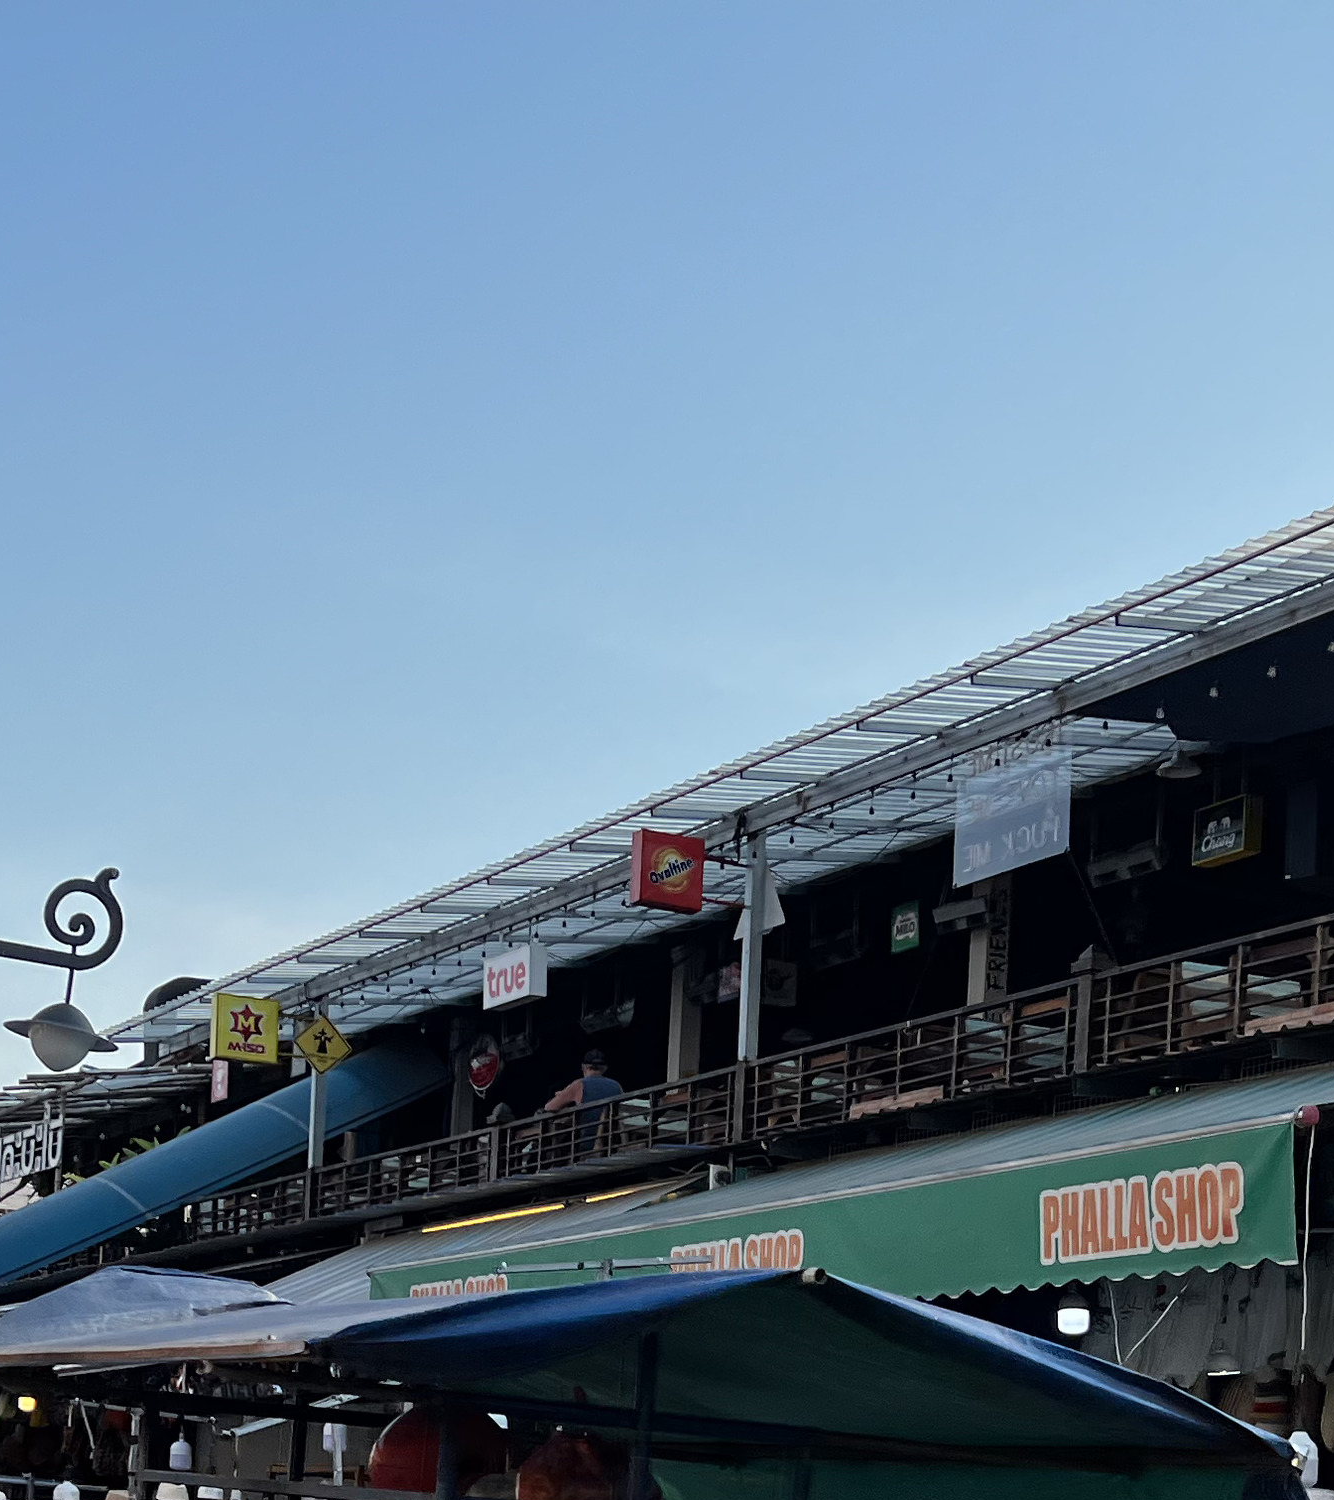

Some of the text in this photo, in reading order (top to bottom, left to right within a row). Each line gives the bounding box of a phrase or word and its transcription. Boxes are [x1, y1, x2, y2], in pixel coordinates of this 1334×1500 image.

[1201, 832, 1236, 853] Chang
[649, 858, 695, 885] Ovaltine
[895, 920, 916, 937] MILO
[487, 961, 526, 998] true
[1041, 1163, 1243, 1264] PHALLA SHOP
